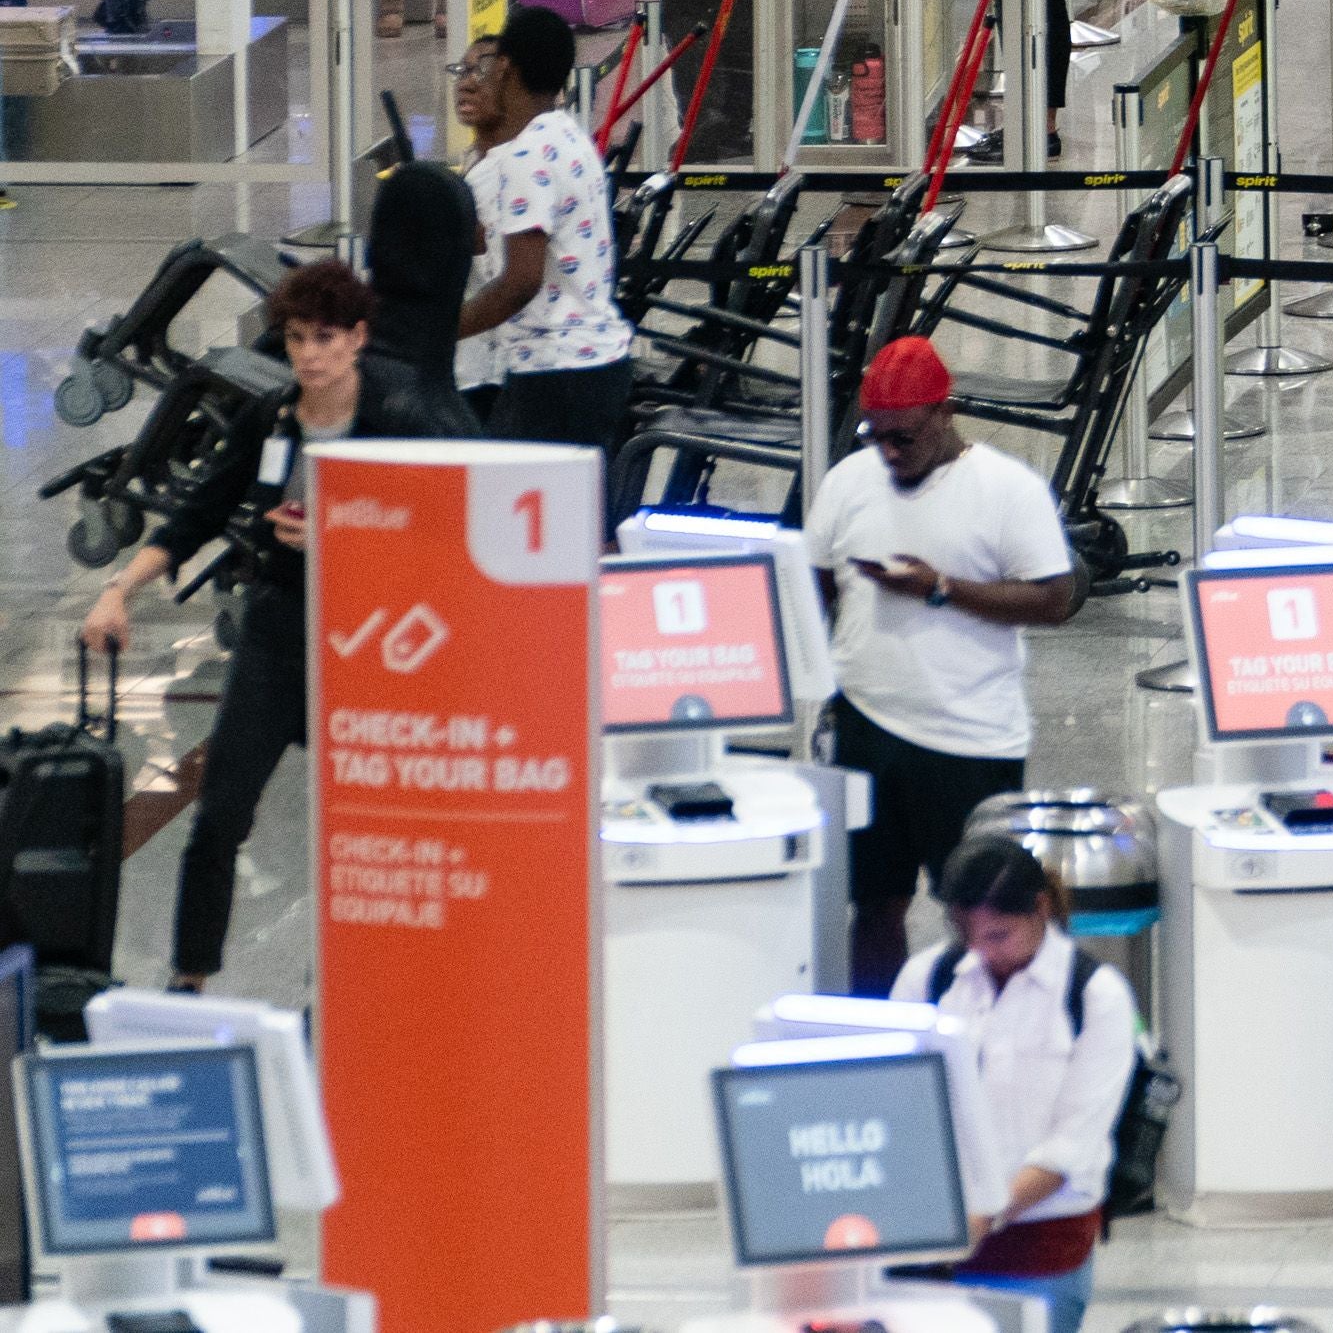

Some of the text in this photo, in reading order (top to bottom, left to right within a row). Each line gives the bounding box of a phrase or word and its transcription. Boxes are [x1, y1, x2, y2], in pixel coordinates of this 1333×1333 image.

[684, 174, 728, 187] spirit
[1236, 175, 1278, 188] spirit
[749, 266, 793, 279] spirit
[512, 487, 544, 554] 1
[668, 589, 687, 624] 1
[1282, 598, 1299, 630] 1
[613, 643, 756, 671] TAG YOUR BAG
[1228, 656, 1266, 678] TAG
[1271, 652, 1323, 675] YOUR
[329, 708, 486, 749] CHECK-IN
[330, 750, 571, 793] TAG YOUR BAG
[329, 833, 445, 866] CHECK-IN
[787, 1118, 887, 1159] HELLO
[800, 1156, 884, 1194] HOLA
